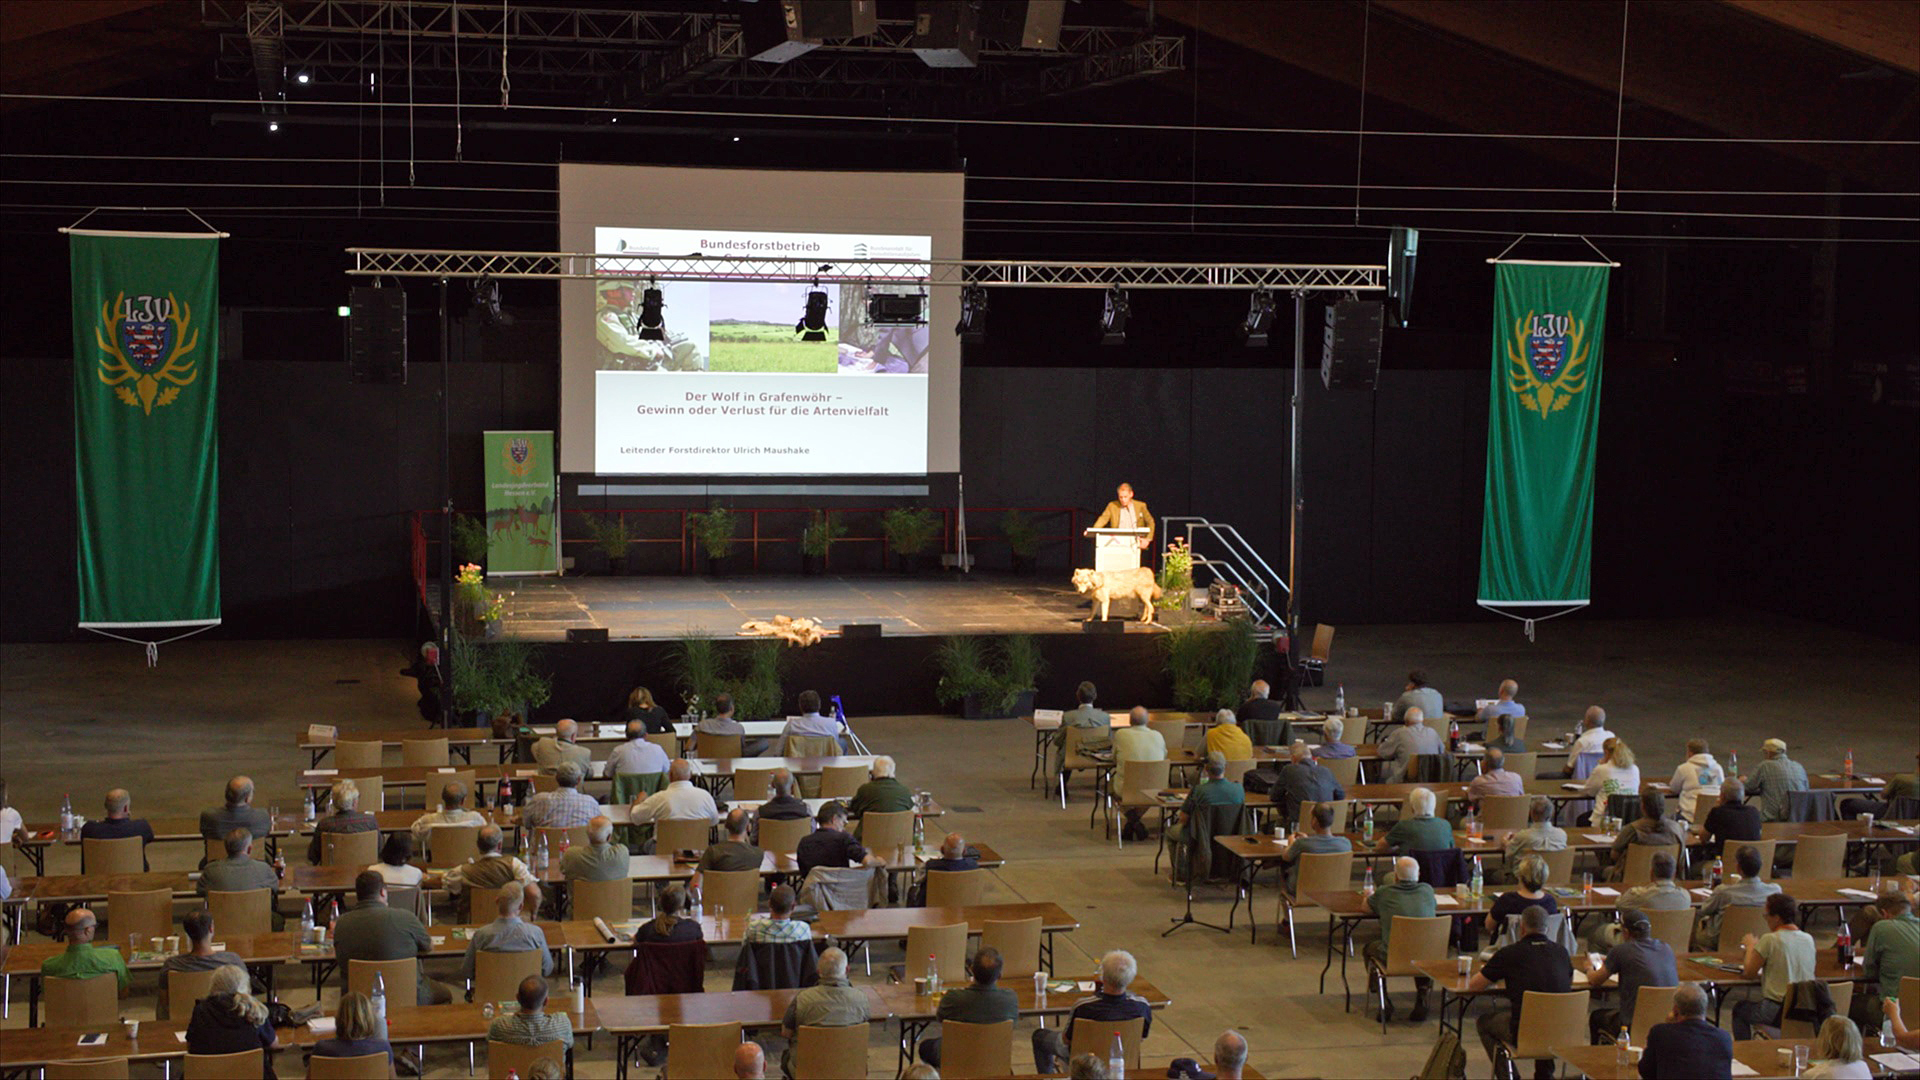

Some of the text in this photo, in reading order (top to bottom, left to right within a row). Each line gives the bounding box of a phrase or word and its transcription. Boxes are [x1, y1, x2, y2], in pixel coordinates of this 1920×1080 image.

[700, 238, 821, 252] Bundesforstbetrieb
[124, 295, 171, 323] LJV
[1532, 313, 1569, 338] LJV
[685, 391, 707, 402] Der
[711, 391, 740, 402] Wolf
[743, 391, 756, 402] in
[758, 392, 832, 403] Grafenwöhr
[636, 404, 889, 417] Gewinn oder Verlust für die Artenvielfalt
[620, 446, 810, 455] Leitender Forstdirektor Ulrich Maushake
